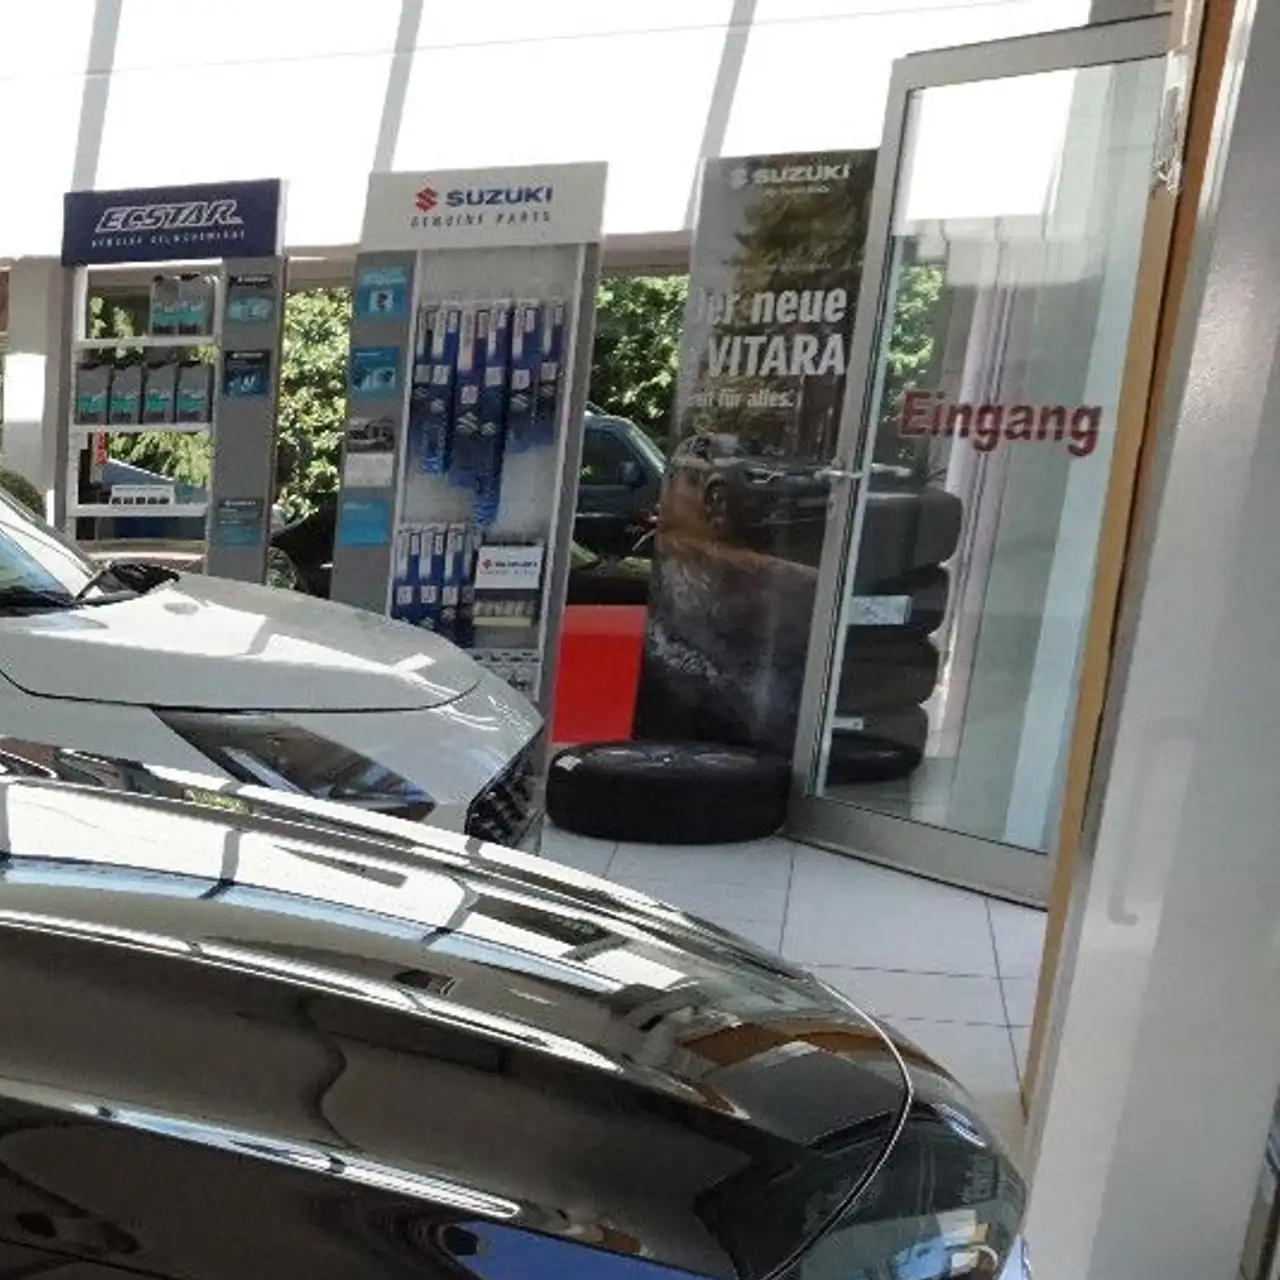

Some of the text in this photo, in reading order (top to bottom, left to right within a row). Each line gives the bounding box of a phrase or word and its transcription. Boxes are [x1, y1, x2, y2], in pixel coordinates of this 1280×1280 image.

[754, 163, 850, 184] SUZUKI
[445, 182, 553, 208] SUZUKI
[95, 199, 244, 234] ECSTAR
[496, 210, 551, 224] PARTS
[750, 287, 847, 324] neue
[707, 332, 845, 378] VITARA
[900, 390, 1103, 457] Eingang
